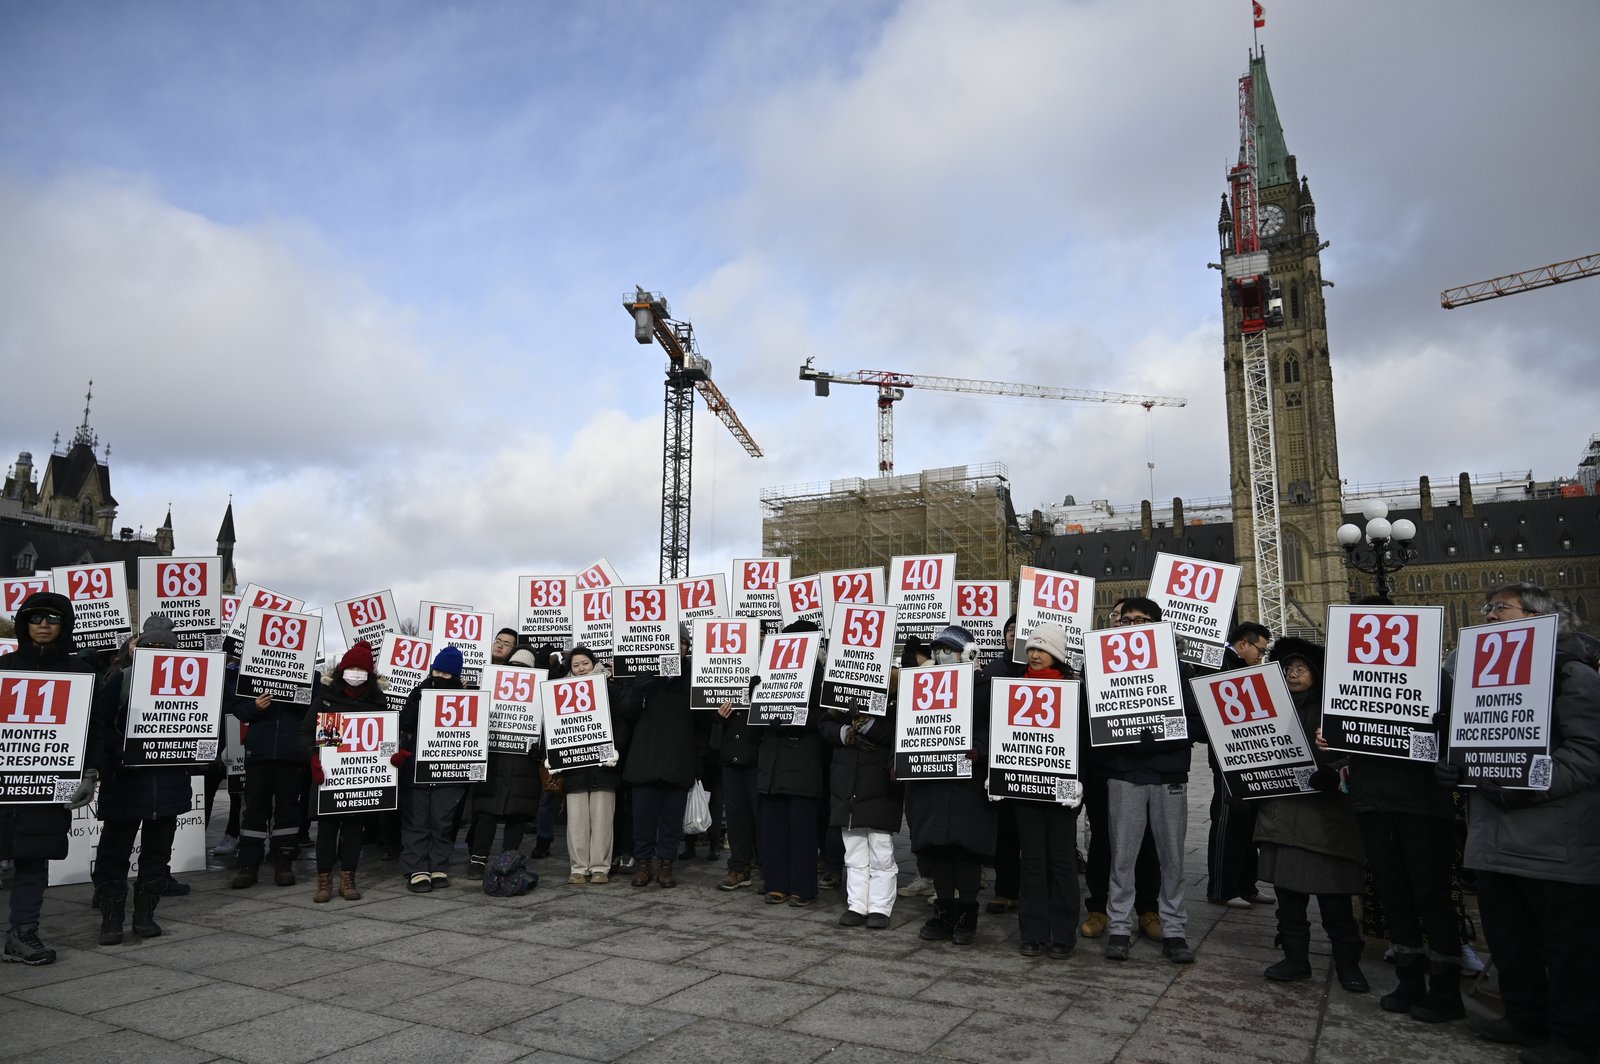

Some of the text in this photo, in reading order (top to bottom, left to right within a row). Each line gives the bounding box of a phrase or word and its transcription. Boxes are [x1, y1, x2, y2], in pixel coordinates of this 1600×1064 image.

[163, 564, 202, 597] 68
[748, 563, 775, 589] 34
[906, 561, 938, 590] 40
[1173, 563, 1216, 601] 30
[73, 570, 107, 600] 29
[838, 574, 869, 602] 22
[534, 581, 566, 607] 38
[682, 581, 712, 608] 72
[793, 580, 821, 610] 34
[962, 587, 993, 616] 33
[1038, 577, 1074, 611] 46
[75, 602, 109, 611] MONTHS
[353, 598, 382, 625] 30
[587, 592, 612, 620] 40
[631, 591, 661, 621] 53
[1168, 600, 1208, 614] MONTHS
[266, 616, 300, 648] 68
[450, 614, 478, 640] 30
[848, 610, 880, 646] 53
[712, 624, 741, 654] 15
[1356, 616, 1410, 665] 33
[261, 649, 296, 660] MONTHS
[396, 640, 427, 669] 30
[774, 640, 800, 669] 71
[843, 649, 874, 660] MONTHS
[1108, 632, 1150, 672] 39
[1478, 630, 1528, 687] 27
[252, 656, 304, 670] WAITING FOR
[835, 659, 880, 672] WAITING FOR
[158, 658, 200, 696] 19
[245, 665, 308, 679] IRCC RESPONSE
[1110, 674, 1153, 686] MONTHS
[1353, 670, 1406, 684] MONTHS
[262, 680, 297, 690] TIMELINES
[500, 672, 531, 702] 55
[918, 672, 953, 710] 34
[1100, 684, 1167, 699] WAITING FOR
[1339, 684, 1421, 700] WAITING FOR
[7, 680, 56, 723] 11
[154, 701, 198, 709] MONTHS
[559, 682, 591, 715] 28
[1095, 696, 1175, 712] IRCC RESPONSE
[1220, 677, 1269, 723] 81
[1476, 692, 1521, 706] MONTHS
[440, 696, 473, 727] 51
[1014, 687, 1055, 727] 23
[1331, 698, 1429, 717] IRCC RESPONSE
[142, 712, 207, 721] WAITING FOR
[561, 714, 592, 725] MONTHS
[916, 714, 951, 724] MONTHS
[1120, 714, 1166, 725] TIMELINES
[1464, 709, 1533, 723] WAITING FOR
[0, 730, 56, 740] MONTHS
[134, 724, 212, 733] IRCC RESPONSE
[340, 718, 379, 752] 40
[554, 725, 584, 735] WAITING
[906, 725, 960, 735] WAITING FOR
[1231, 724, 1275, 738] MONTHS
[1342, 720, 1414, 736] NO TIMELINES
[1456, 726, 1540, 740] IRCC RESPONSE
[550, 731, 607, 745] IRCC RESPONSE
[901, 736, 965, 747] IRCC RESPONSE
[1012, 731, 1053, 742] MONTHS
[1225, 735, 1292, 752] WAITING FOR
[1346, 733, 1409, 749] NO RESULTS
[573, 753, 599, 762] RESULTS
[1002, 743, 1064, 756] WAITING FOR
[1224, 746, 1304, 765] IRCC RESPONSE
[1465, 752, 1526, 763] NO TIMELINES
[341, 756, 377, 764] MONTHS
[996, 754, 1070, 768] IRCC RESPONSE
[331, 766, 367, 775] WAITING
[1468, 766, 1521, 777] NO RESULTS
[325, 775, 391, 786] IRCC RESPONSE
[1248, 778, 1299, 790] NO RESULTS
[345, 790, 382, 798] TIMELINES
[1021, 784, 1056, 794] RESULTS
